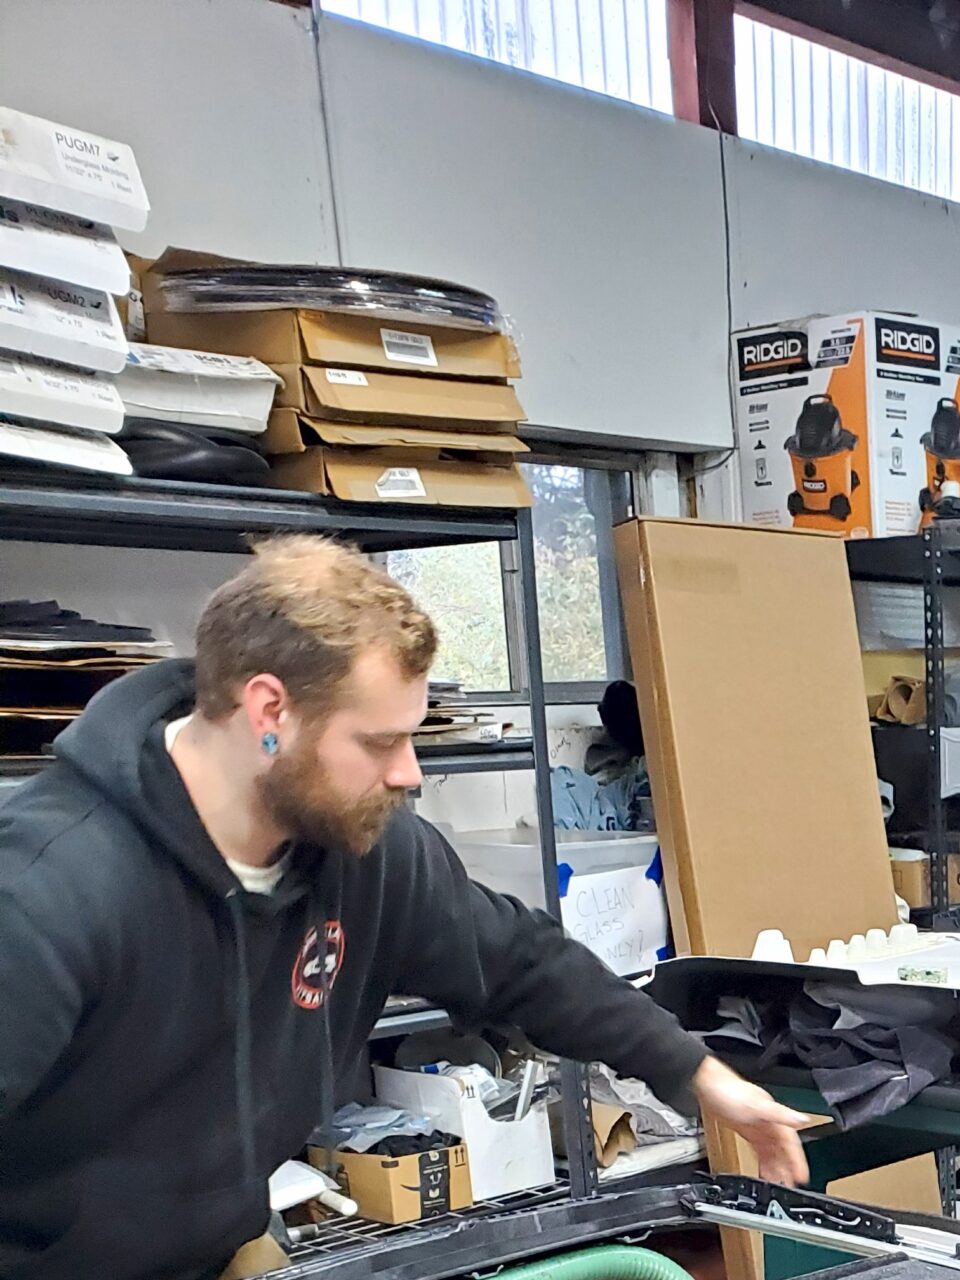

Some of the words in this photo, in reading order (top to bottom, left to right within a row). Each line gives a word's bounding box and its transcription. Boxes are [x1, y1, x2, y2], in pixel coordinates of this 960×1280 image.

[55, 131, 101, 156] PUGM7
[743, 338, 802, 365] RIDGID
[880, 327, 936, 355] RIDGID
[576, 886, 635, 918] CLEAN
[572, 917, 625, 945] GLASS
